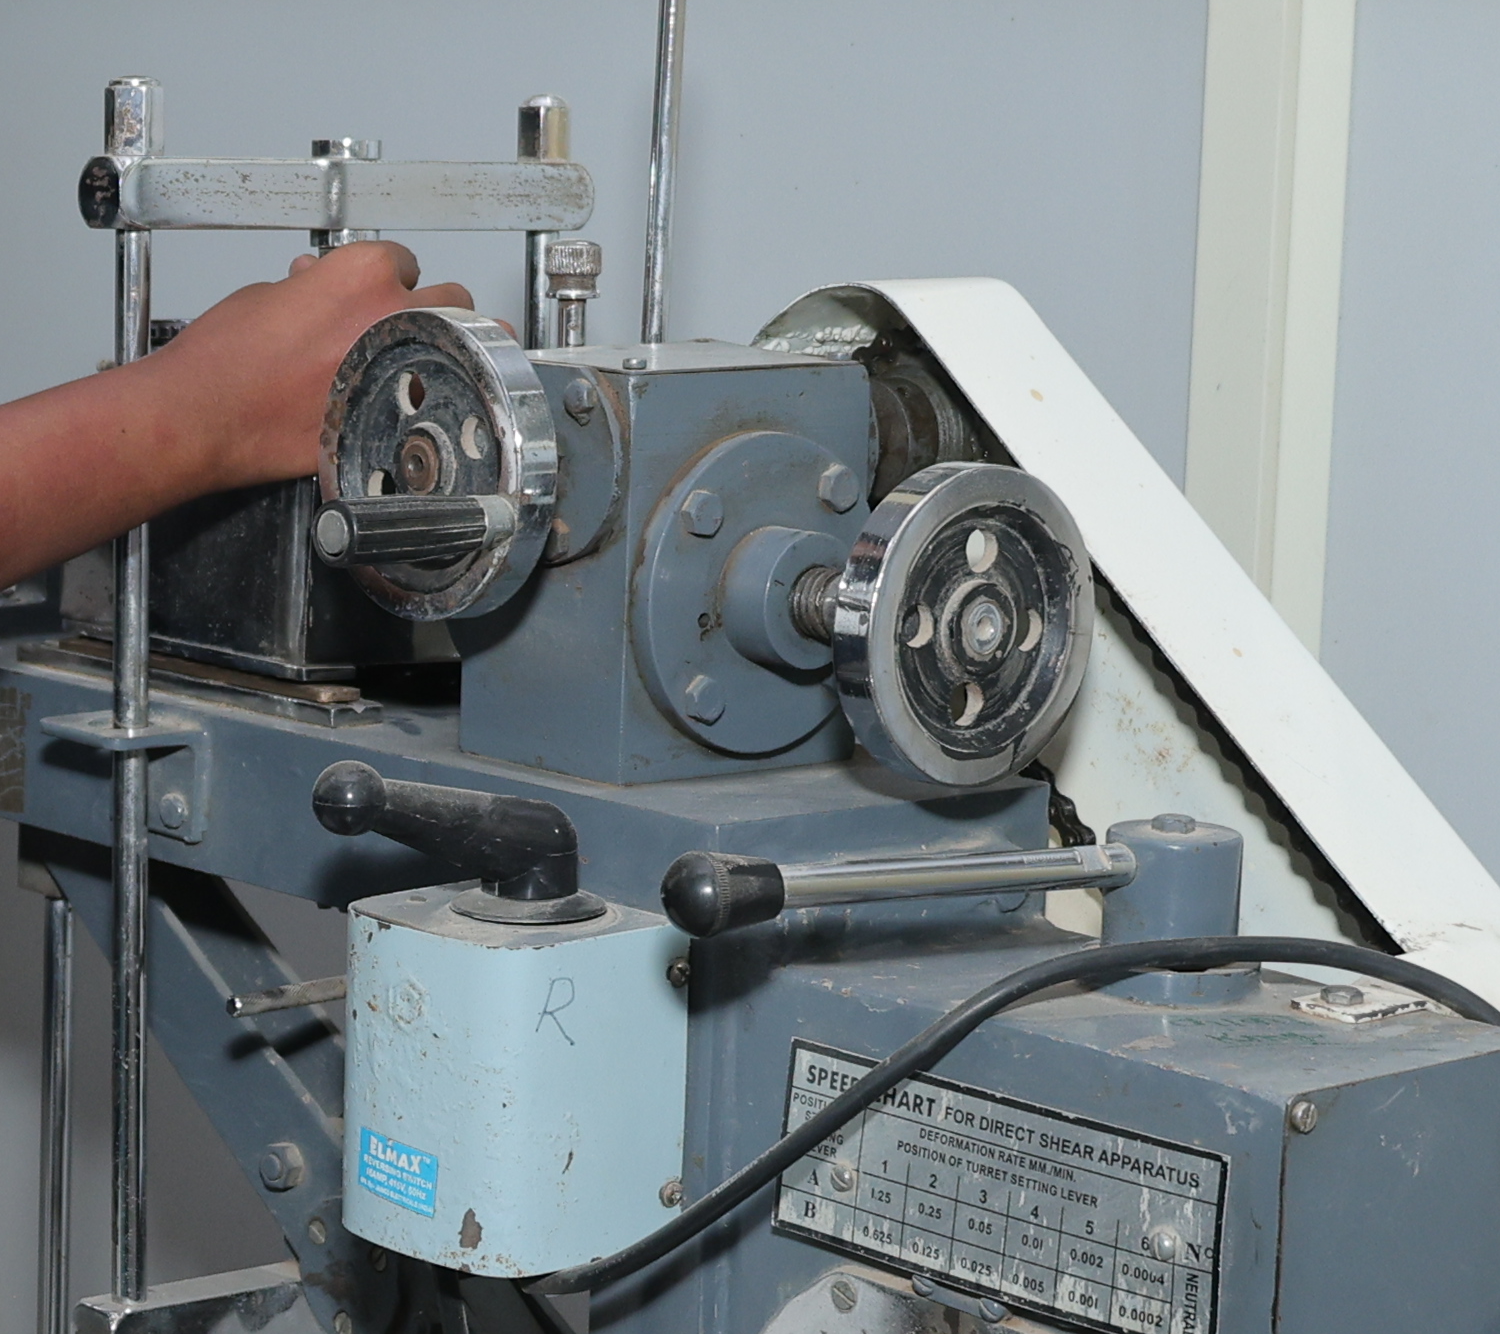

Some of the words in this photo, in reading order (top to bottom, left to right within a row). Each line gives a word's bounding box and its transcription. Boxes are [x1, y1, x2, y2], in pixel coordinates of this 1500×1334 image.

[535, 977, 575, 1046] R
[369, 1134, 421, 1175] ELMAX
[897, 1139, 946, 1165] POSITION
[948, 1153, 963, 1169] OF
[965, 1158, 1009, 1182] TURRET
[1010, 1170, 1059, 1198] SETTING
[1060, 1188, 1099, 1210] LEVER
[919, 1127, 996, 1160] DEFORMATION
[998, 1148, 1027, 1168] RATE
[945, 1106, 975, 1129] FOR
[979, 1114, 1036, 1144] DIRECT
[1039, 1132, 1095, 1162] SHEAR
[1098, 1148, 1201, 1189] APPARATUS
[807, 1167, 820, 1186] A
[870, 1187, 892, 1204] 1.25
[917, 1202, 942, 1220] 0.25
[967, 1218, 993, 1235] 0.05
[1021, 1234, 1044, 1251] 0.01
[1069, 1248, 1104, 1268] 0.002
[1122, 1263, 1166, 1285] 0.0004
[881, 1160, 888, 1174] 1
[929, 1174, 938, 1189] 2
[979, 1189, 988, 1204] 3
[1030, 1205, 1040, 1220] 4
[1085, 1221, 1095, 1235] 5
[1141, 1236, 1150, 1251] 6
[803, 1199, 817, 1218] B
[862, 1225, 893, 1245] 0.625
[912, 1240, 940, 1260] 0.125
[960, 1256, 992, 1276] 0.025
[1011, 1273, 1045, 1293] 0.005
[1067, 1290, 1099, 1309] 0.001
[1118, 1305, 1163, 1327] 0.0002
